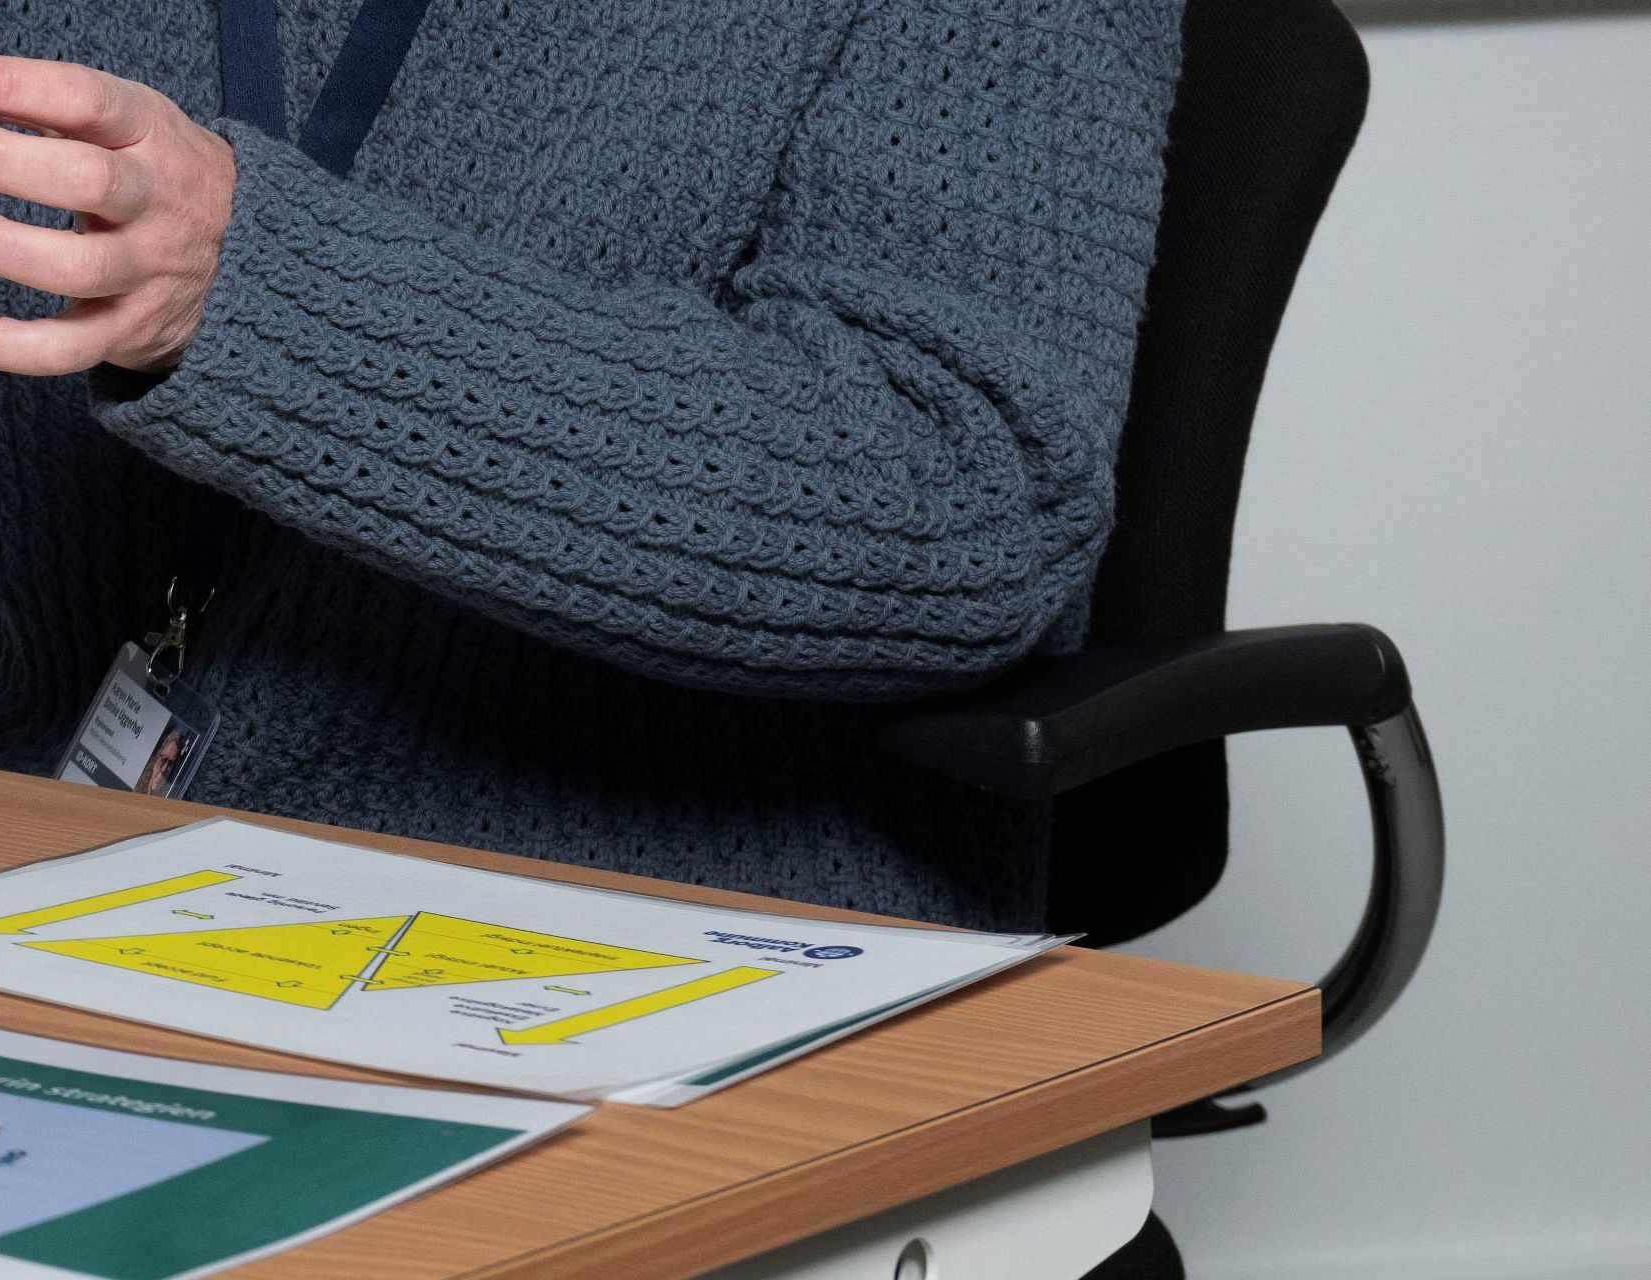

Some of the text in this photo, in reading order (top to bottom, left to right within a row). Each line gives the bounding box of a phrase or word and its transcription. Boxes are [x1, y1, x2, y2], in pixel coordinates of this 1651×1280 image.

[75, 750, 99, 775] ID-KORT
[225, 863, 283, 878] Minimal
[337, 923, 383, 935] Ingen
[702, 930, 815, 949] Kommune
[480, 933, 621, 962] Intellektuel indsigt
[707, 936, 800, 953] Aalborg
[196, 941, 324, 971] Voksende accept
[423, 952, 530, 976] Aktuel indsigt
[756, 956, 825, 969] Minimal
[139, 960, 232, 984] Fuld accept
[447, 995, 546, 1018] Metakognitive
[452, 1003, 531, 1022] Eksekutive
[447, 1009, 516, 1026] Kognitive
[45, 1086, 217, 1120] strategien
